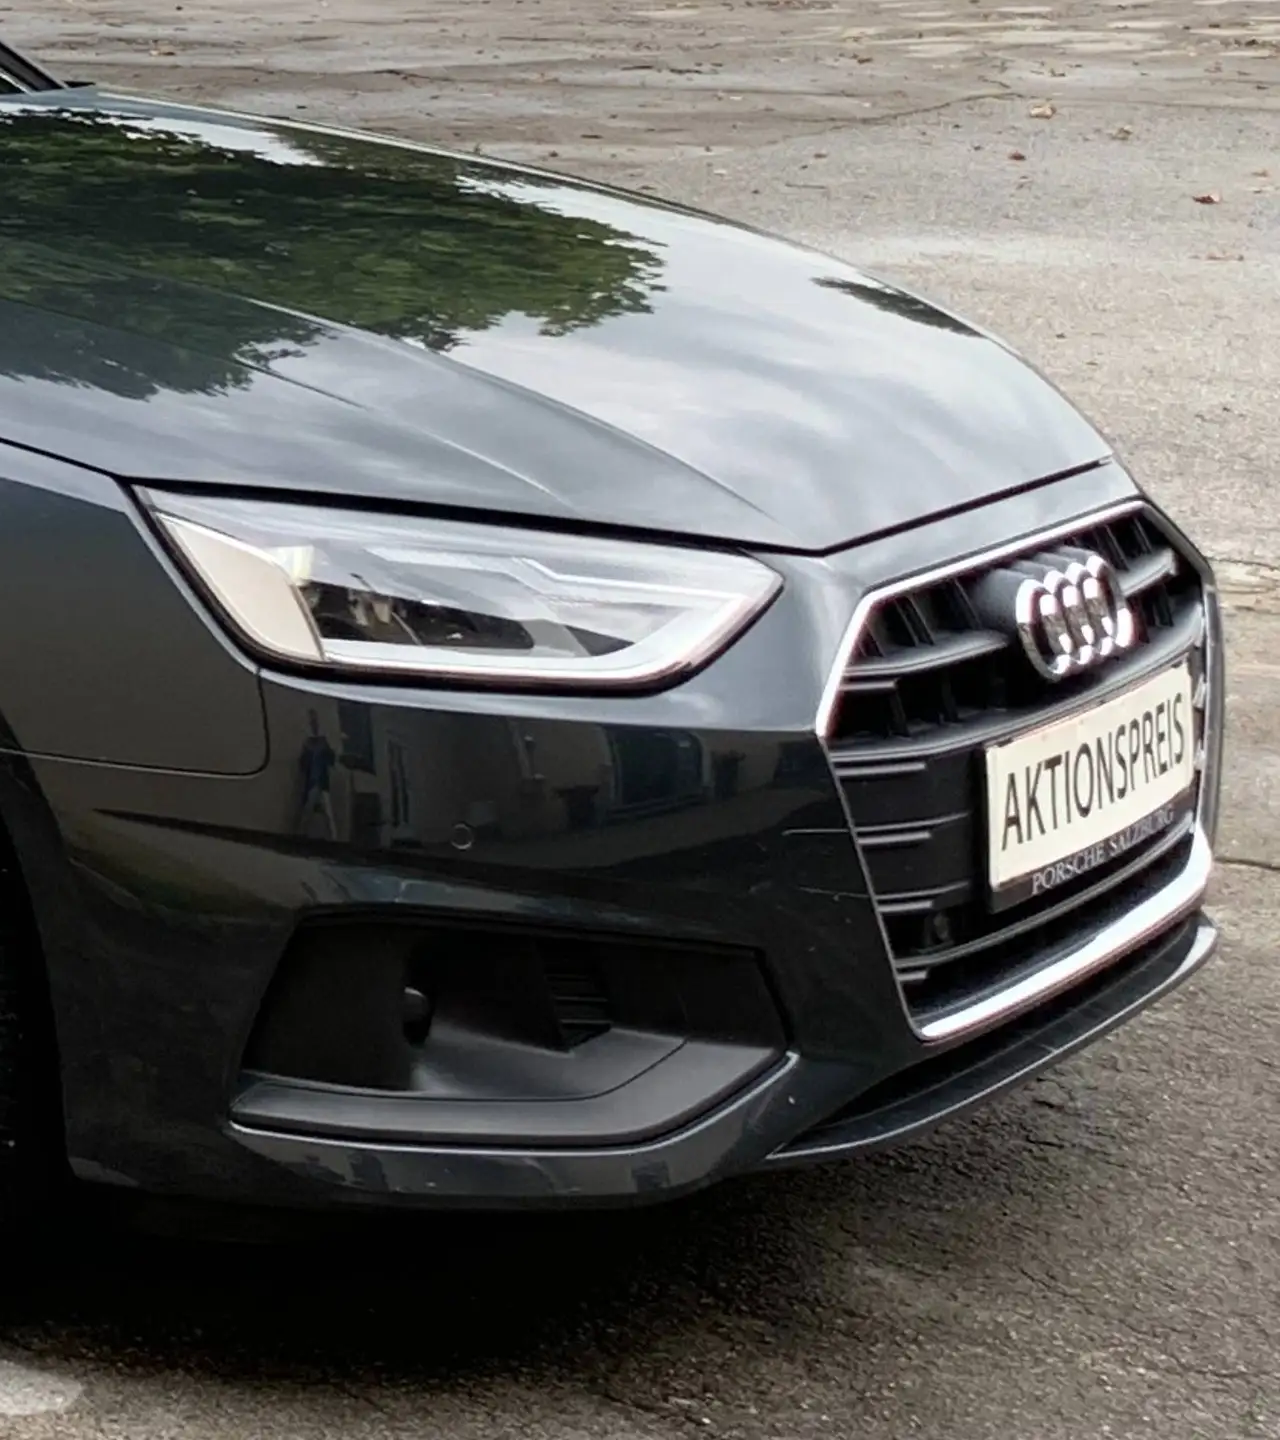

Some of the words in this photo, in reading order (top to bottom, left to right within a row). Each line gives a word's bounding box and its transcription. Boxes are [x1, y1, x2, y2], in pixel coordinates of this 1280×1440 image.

[1000, 691, 1186, 852] AKTIONSPREIS
[1031, 844, 1105, 896] PORSCHE
[1108, 803, 1175, 859] SALZBURG
